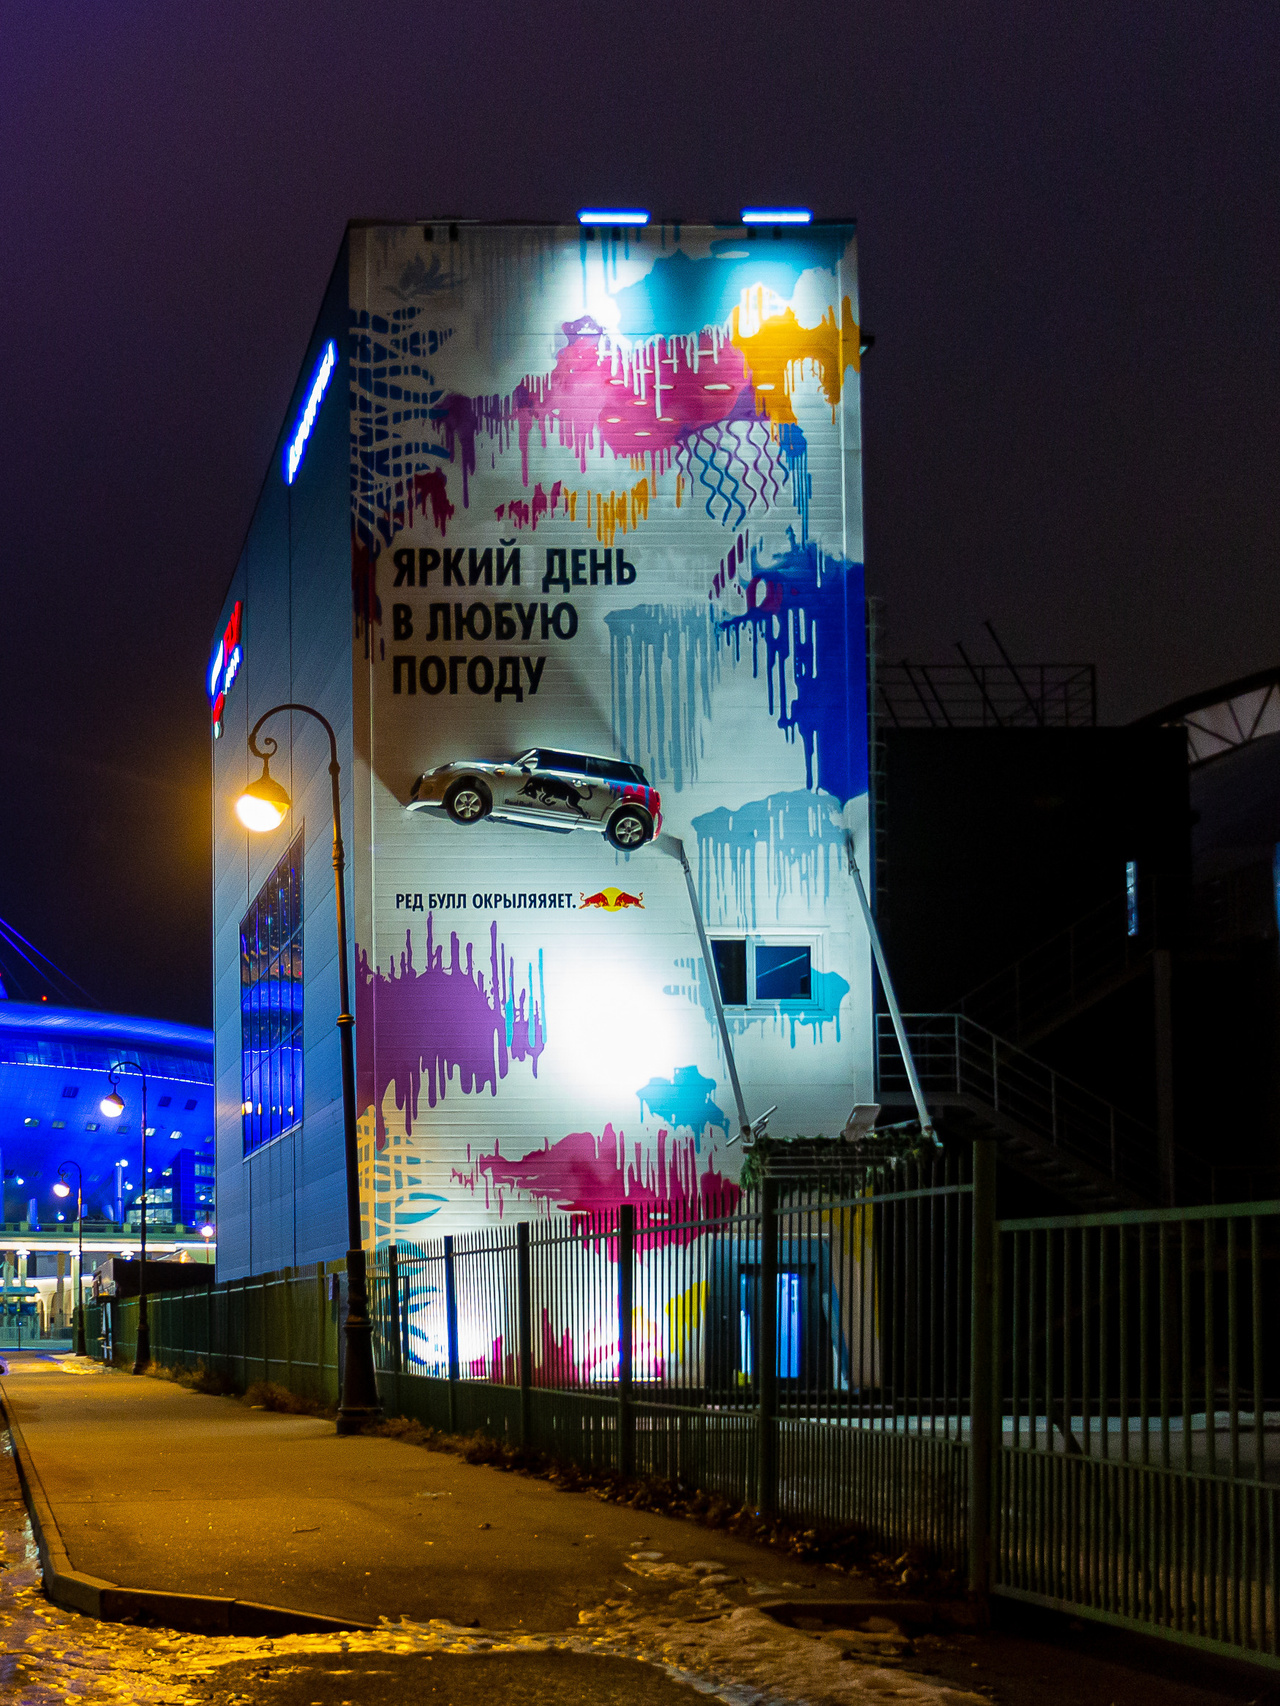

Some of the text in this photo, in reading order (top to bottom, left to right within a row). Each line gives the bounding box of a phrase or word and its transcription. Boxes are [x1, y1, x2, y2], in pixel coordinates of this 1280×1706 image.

[392, 538, 638, 594] ЯРКИЙ ДЕНЬ
[392, 602, 579, 641] В ЛЮБУЮ
[392, 655, 547, 703] ПОГОДУ
[395, 892, 576, 912] РЕД БУЛЛ ОКРЫЛЯЯЯЕТ.
